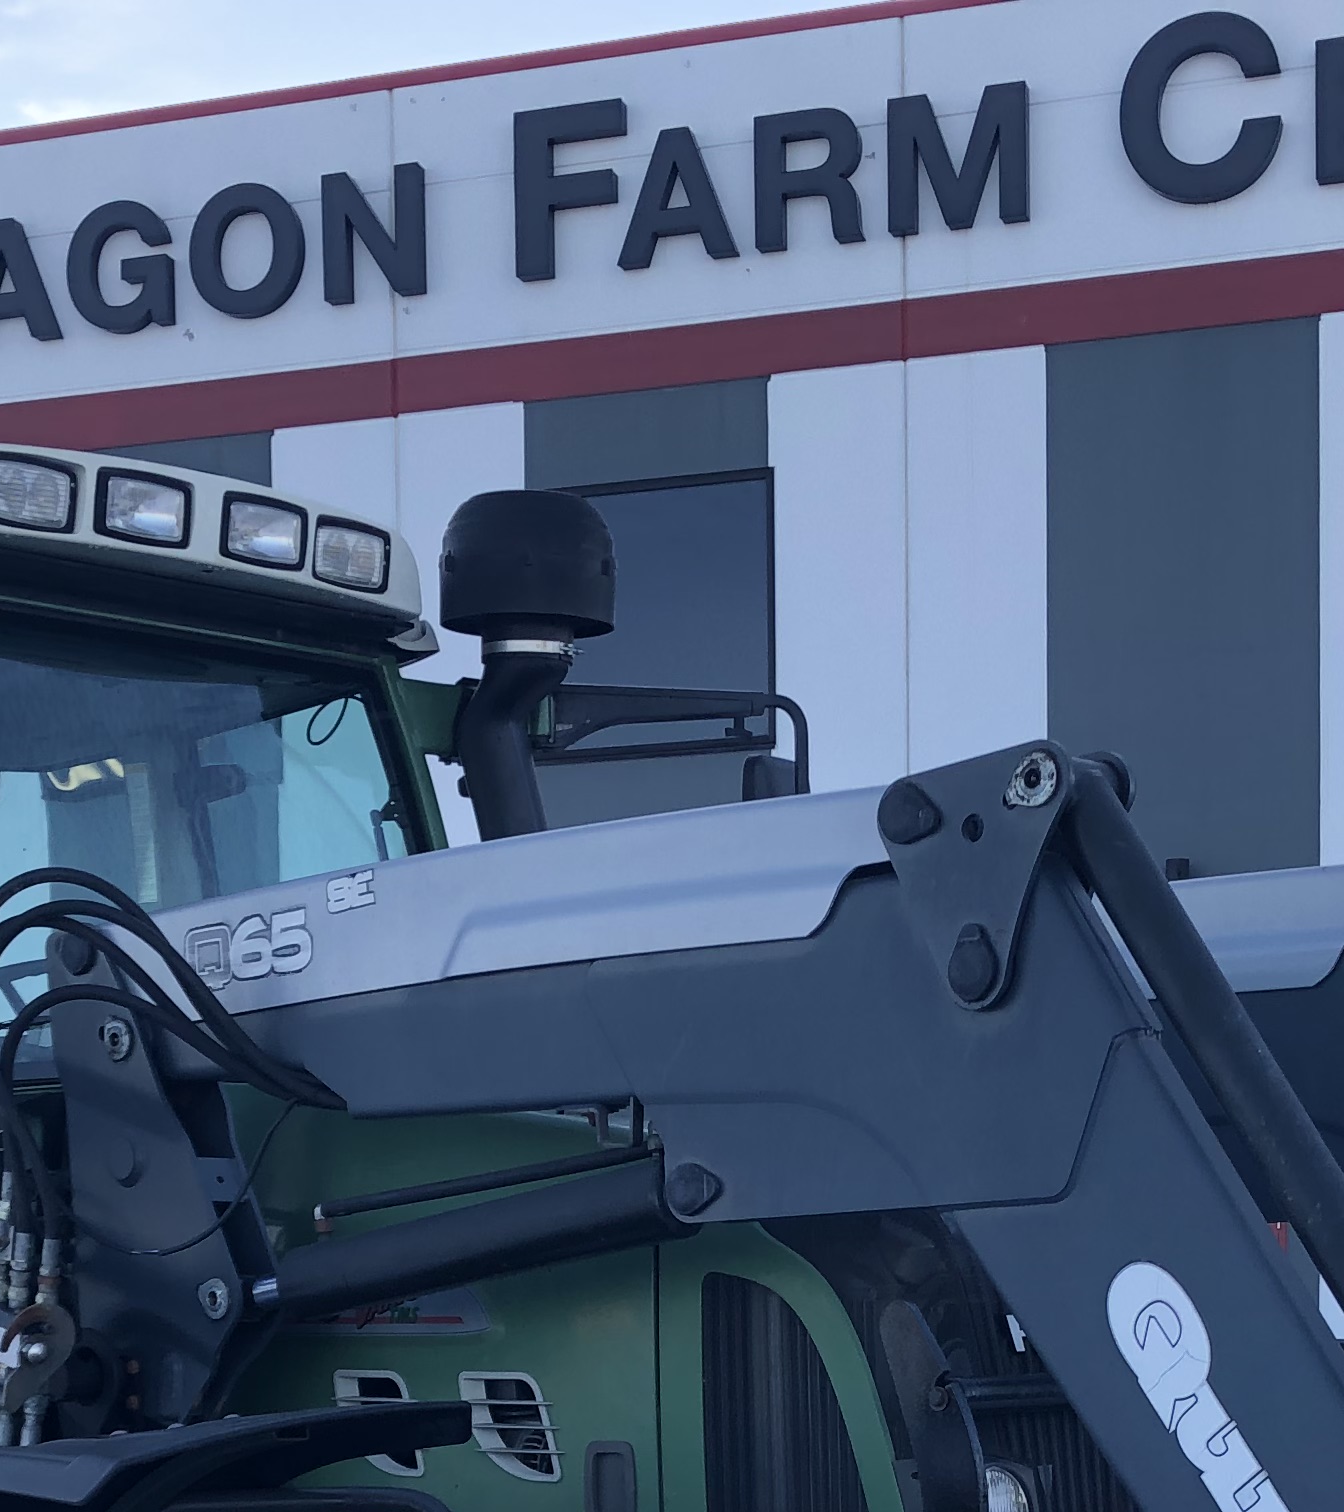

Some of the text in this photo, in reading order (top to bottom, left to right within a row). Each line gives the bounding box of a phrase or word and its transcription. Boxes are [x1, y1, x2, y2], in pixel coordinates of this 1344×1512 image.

[513, 80, 1031, 282] FARM
[184, 868, 376, 991] Q65 SE
